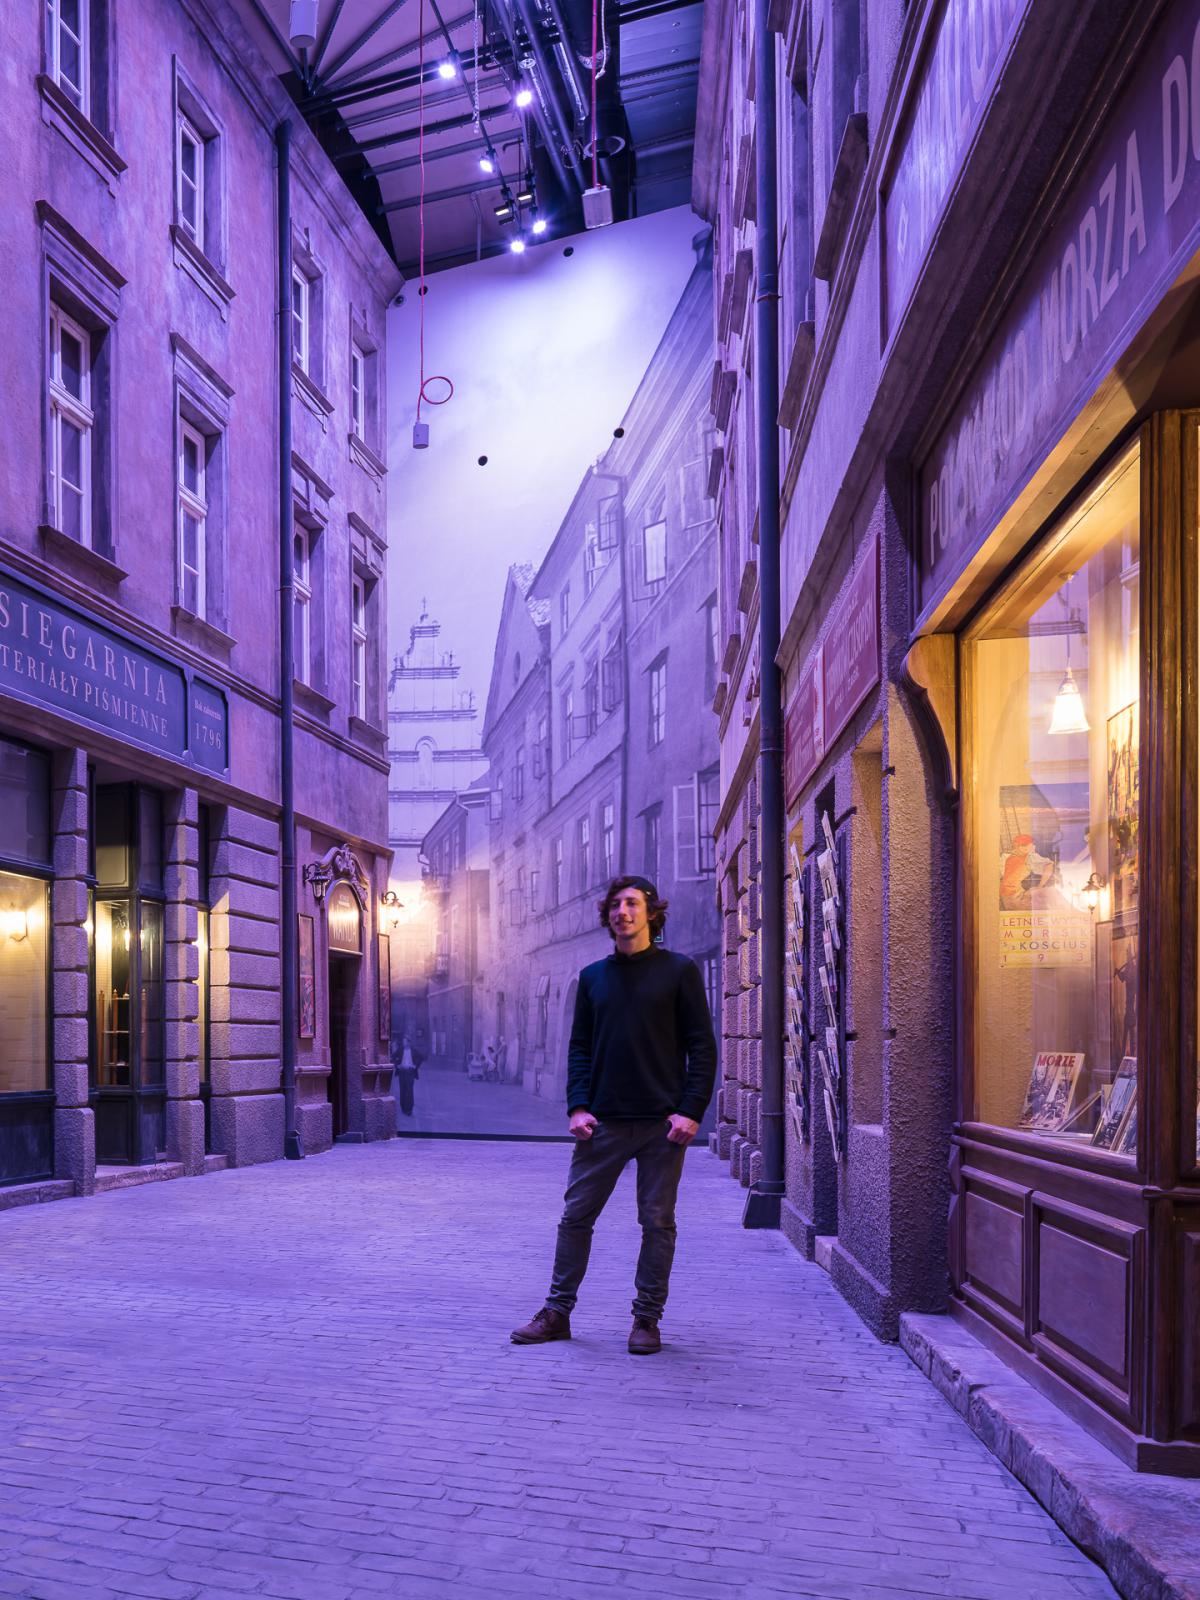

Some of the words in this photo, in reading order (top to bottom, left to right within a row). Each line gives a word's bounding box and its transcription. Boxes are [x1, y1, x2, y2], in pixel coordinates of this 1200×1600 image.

[1040, 129, 1147, 384] MORZA
[84, 682, 168, 738] PIŚMIENNE
[196, 723, 221, 749] 1796
[1003, 917, 1045, 927] LETNIE
[1037, 1055, 1076, 1068] MORZE
